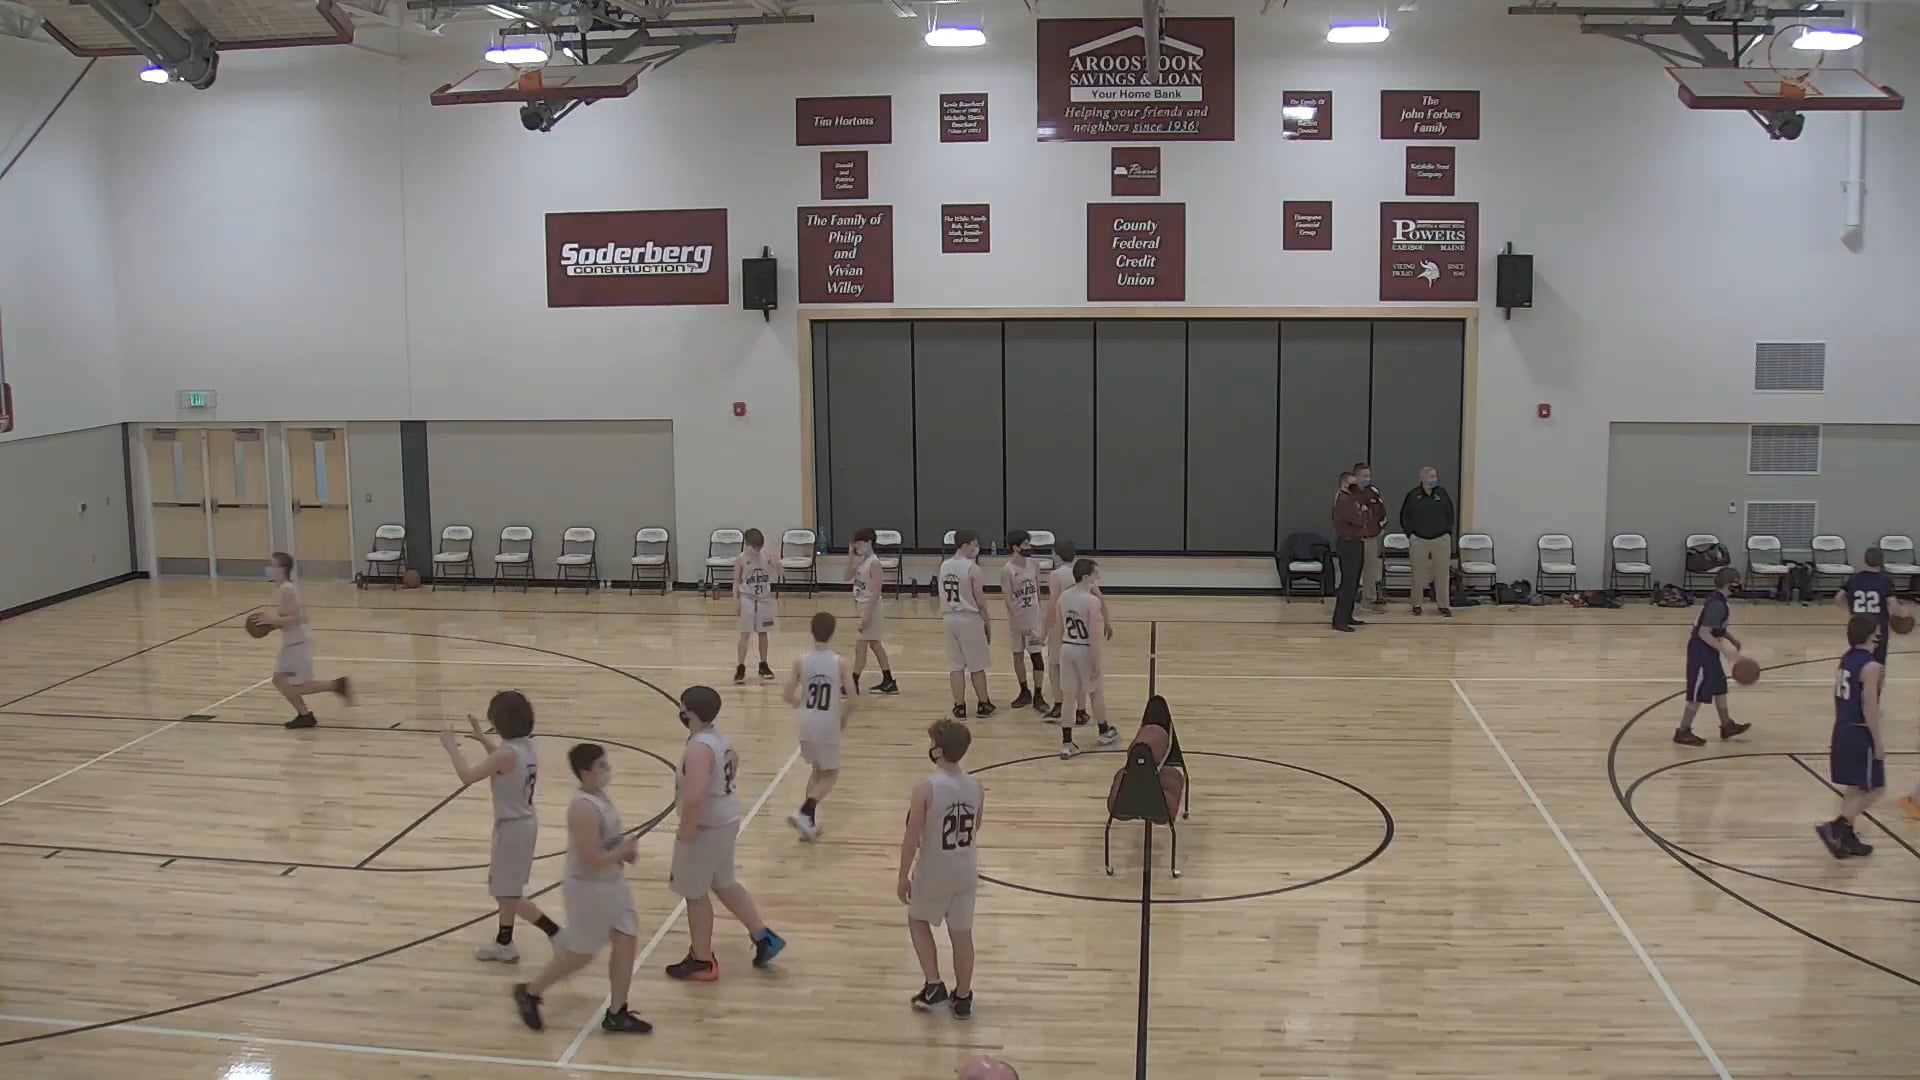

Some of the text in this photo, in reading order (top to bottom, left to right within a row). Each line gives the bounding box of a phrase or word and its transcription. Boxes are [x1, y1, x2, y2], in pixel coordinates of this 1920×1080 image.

[1069, 72, 1203, 86] SAVINGS & LOAN
[1091, 89, 1183, 99] Your Home Bank
[1422, 95, 1440, 106] The
[1064, 105, 1209, 120] Helping your friends and
[1400, 108, 1461, 121] John Forbes
[813, 115, 875, 127] Tim Hortons
[1073, 120, 1130, 135] neighbors
[1132, 123, 1164, 133] since
[1413, 121, 1448, 136] Family
[806, 212, 884, 230] The Family of
[1113, 218, 1158, 235] County
[828, 230, 863, 246] Philip
[1112, 236, 1161, 249] Federal
[561, 241, 713, 274] Soderberg
[834, 247, 857, 259] and
[1116, 254, 1157, 268] Credit
[573, 264, 686, 275] CONSTRUCTION
[828, 263, 863, 277] Vivian
[1117, 273, 1155, 286] Union
[827, 280, 865, 298] Willey
[754, 584, 763, 595] 21
[1853, 590, 1881, 613] 22
[1066, 617, 1089, 640] 20
[806, 683, 831, 711] 30
[942, 814, 974, 850] 25
